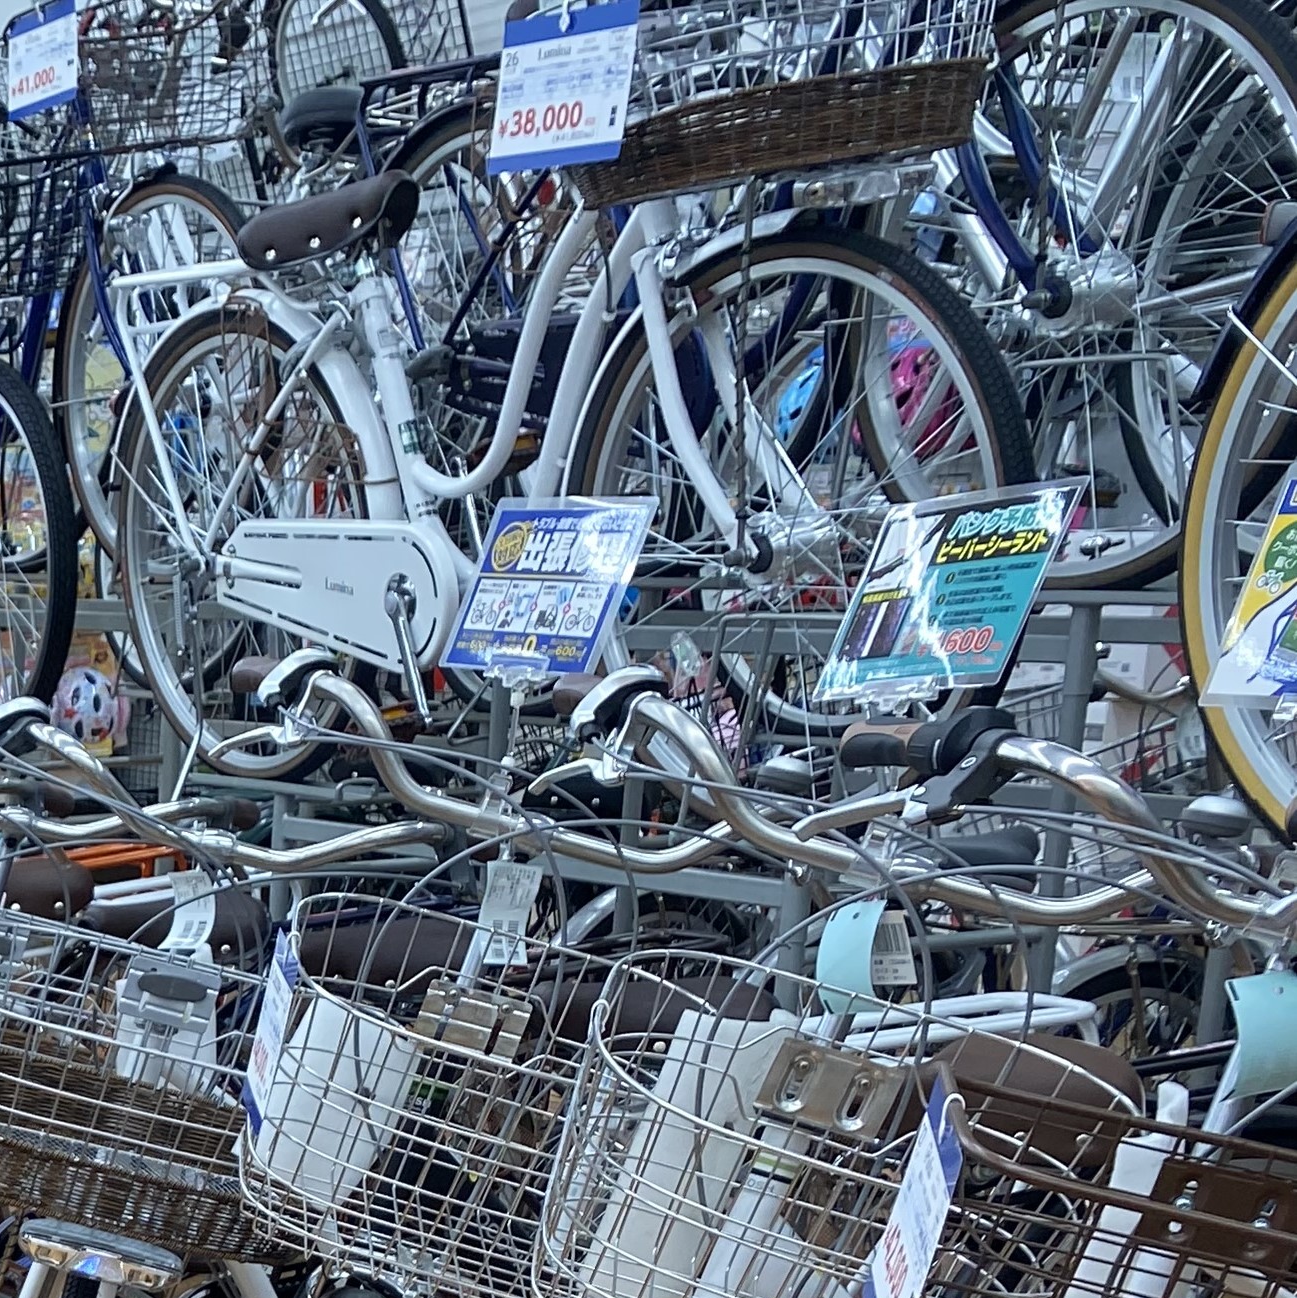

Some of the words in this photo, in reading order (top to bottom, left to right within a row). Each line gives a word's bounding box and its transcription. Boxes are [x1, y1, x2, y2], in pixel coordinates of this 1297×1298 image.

[499, 100, 583, 138] ¥38,000
[947, 497, 1060, 541] パンク予防
[935, 527, 1050, 564] ビーバーシーラント
[325, 576, 354, 596] Lumina
